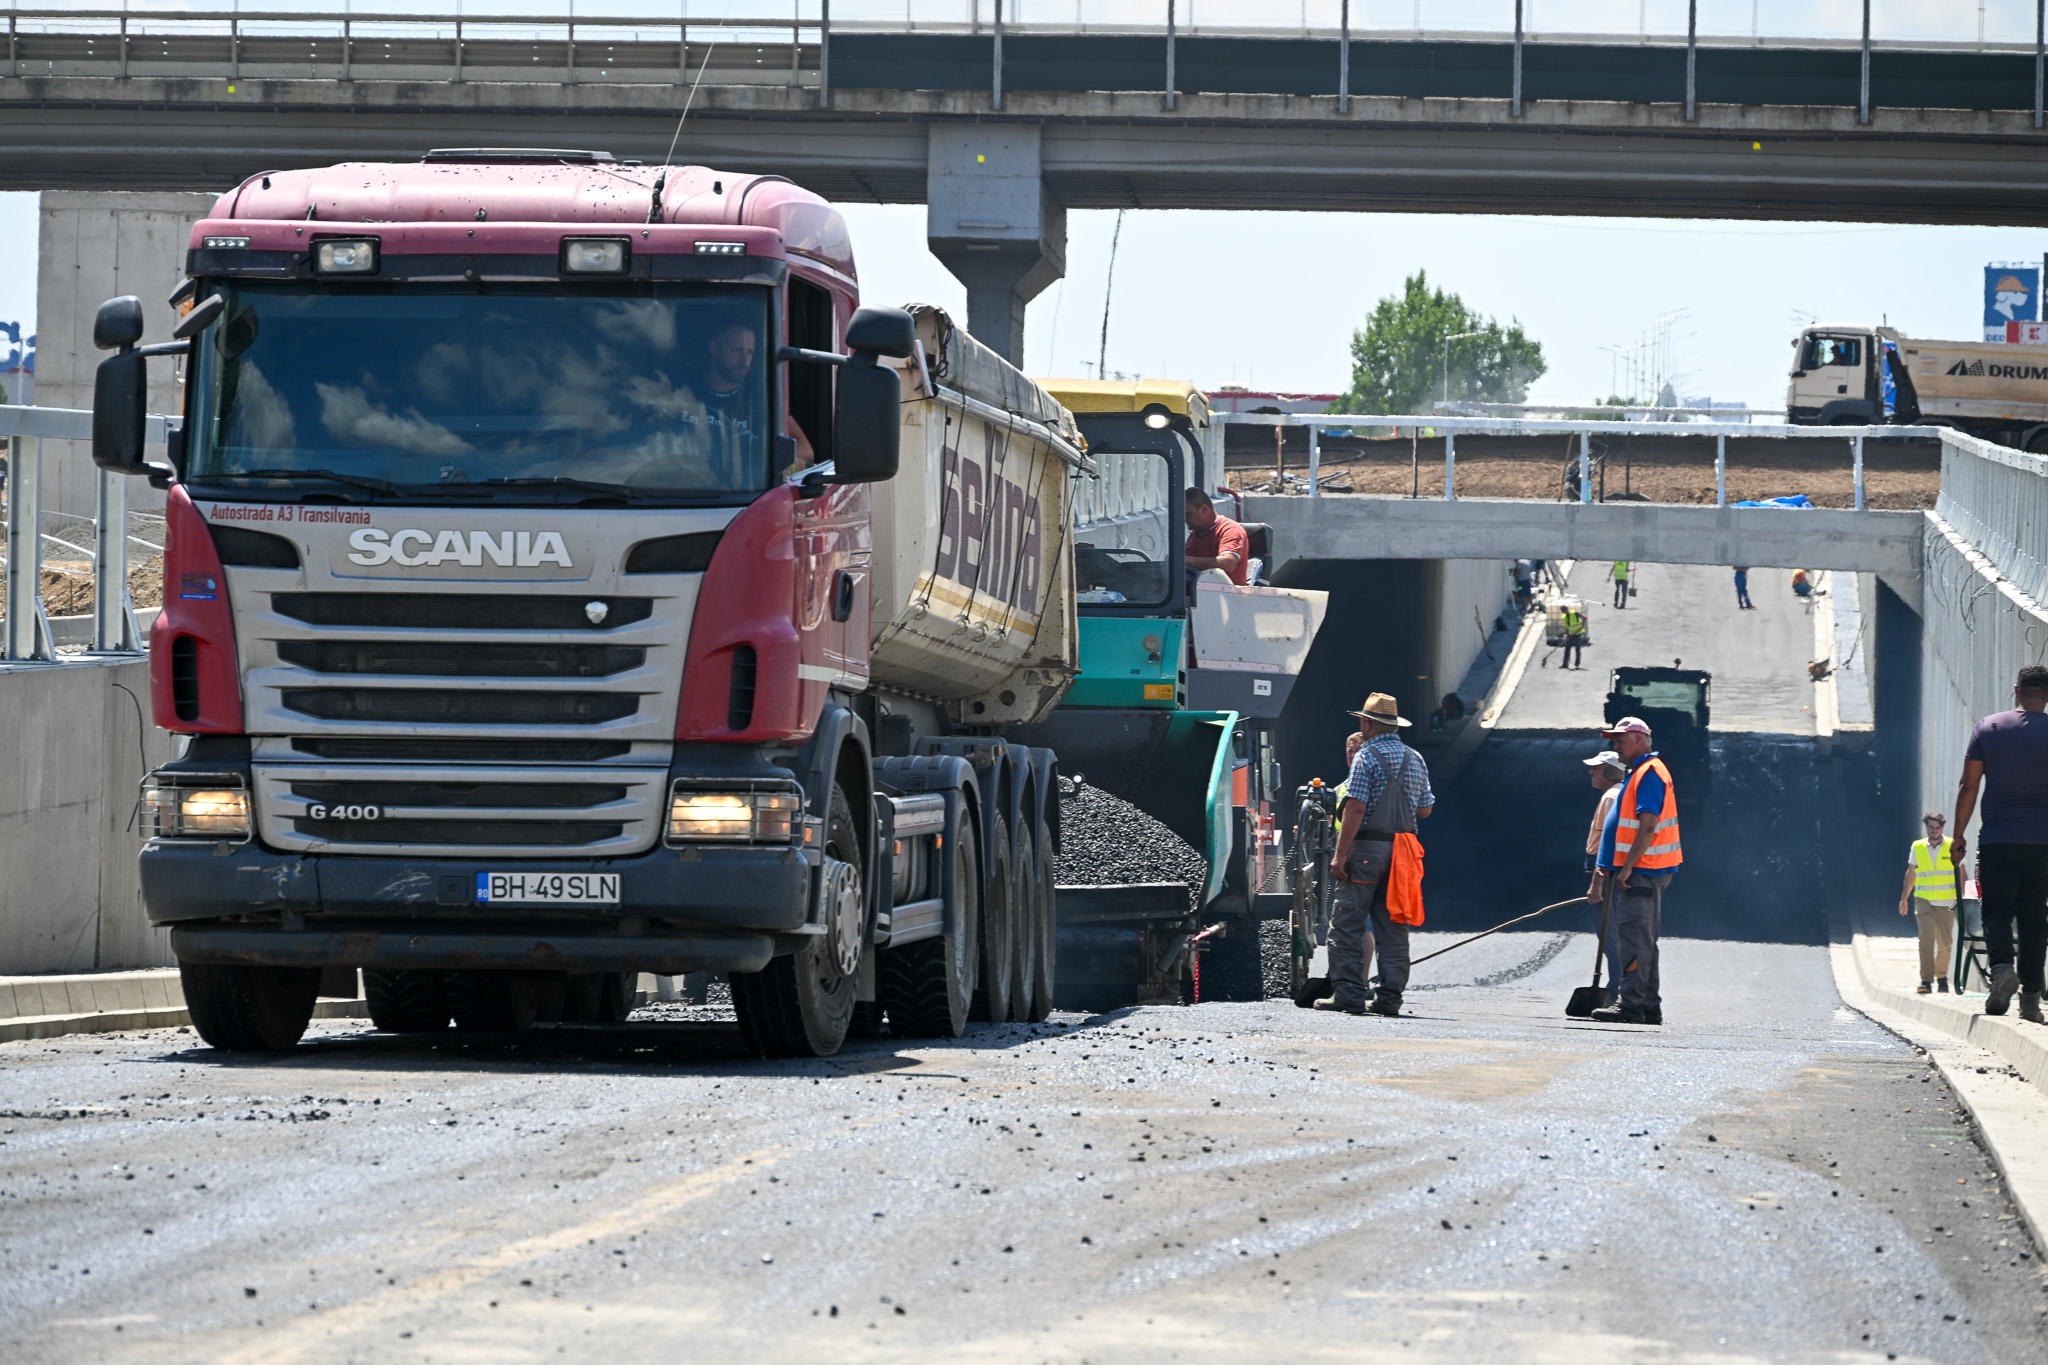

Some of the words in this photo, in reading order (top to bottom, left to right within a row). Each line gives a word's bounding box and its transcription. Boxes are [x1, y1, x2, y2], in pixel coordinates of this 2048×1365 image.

[1988, 364, 2048, 380] DRUM
[210, 503, 274, 521] Autostrada
[277, 505, 294, 522] A3
[298, 506, 372, 525] Transilvania
[935, 421, 1042, 616] selina
[347, 528, 574, 568] SCANIA
[310, 804, 326, 820] G
[330, 805, 379, 820] 400
[491, 875, 526, 899] BH
[535, 875, 564, 899] 49
[567, 876, 617, 900] SLN
